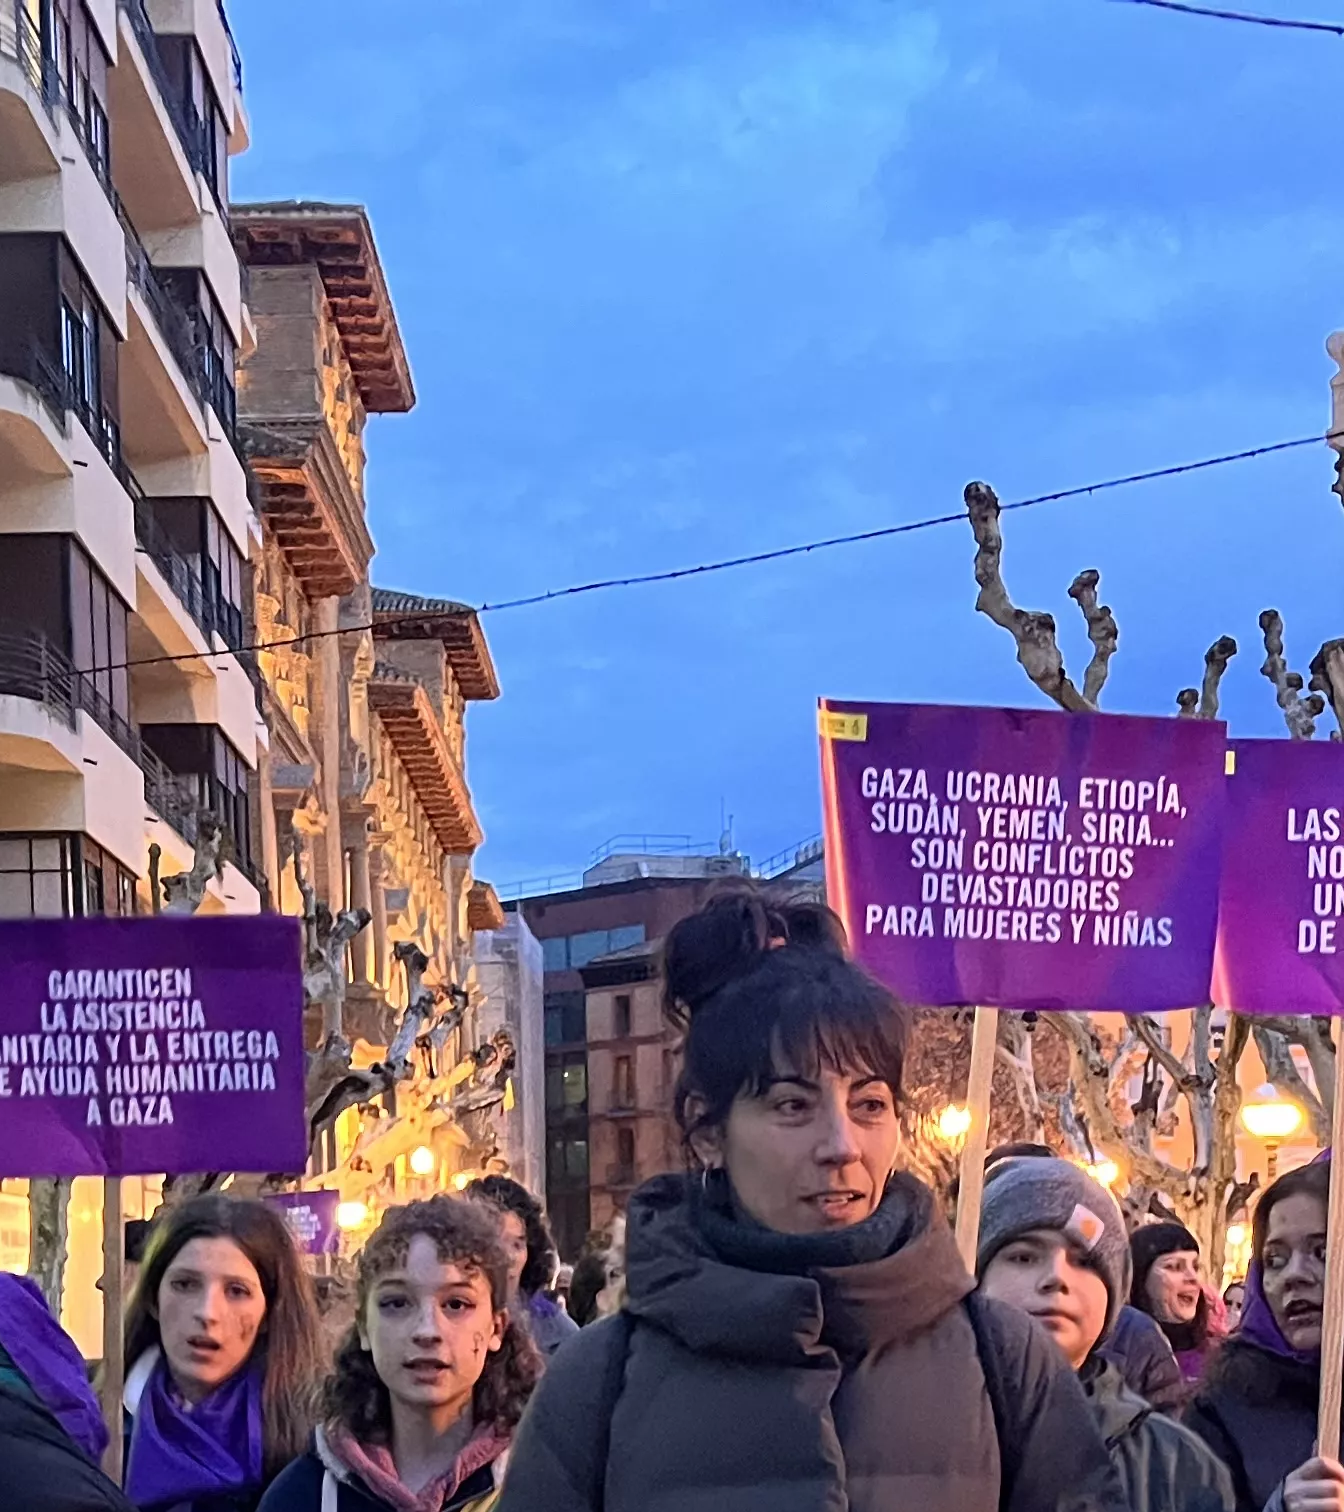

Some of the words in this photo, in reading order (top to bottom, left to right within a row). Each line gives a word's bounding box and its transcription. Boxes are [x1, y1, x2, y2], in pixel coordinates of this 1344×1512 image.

[861, 767, 936, 803] GAZA,
[946, 770, 1069, 811] UCRANIA,
[1079, 775, 1188, 819] ETIOPÍA,
[870, 799, 967, 841] SUDÁN,
[977, 807, 1073, 844] YEMEN,
[1081, 812, 1175, 848] SIRIA...
[1287, 808, 1341, 842] LAS
[911, 840, 964, 871] SON
[973, 841, 1134, 880] CONFLICTOS
[922, 873, 1121, 913] DEVASTADORES
[865, 904, 935, 938] PARA
[943, 908, 1062, 943] MUJERES
[1071, 914, 1086, 945] Y
[1093, 911, 1174, 948] NIÑAS
[1297, 919, 1337, 954] DE
[47, 968, 193, 1001] GARANTICEN
[41, 1004, 67, 1033] LA
[72, 999, 206, 1032] ASISTENCIA
[105, 1034, 121, 1062] Y
[130, 1034, 160, 1062] LA
[167, 1030, 280, 1062] ENTREGA
[20, 1067, 100, 1097] AYUDA
[106, 1062, 277, 1095] HUMANITARIA
[86, 1097, 102, 1127] A
[110, 1095, 175, 1126] GAZA
